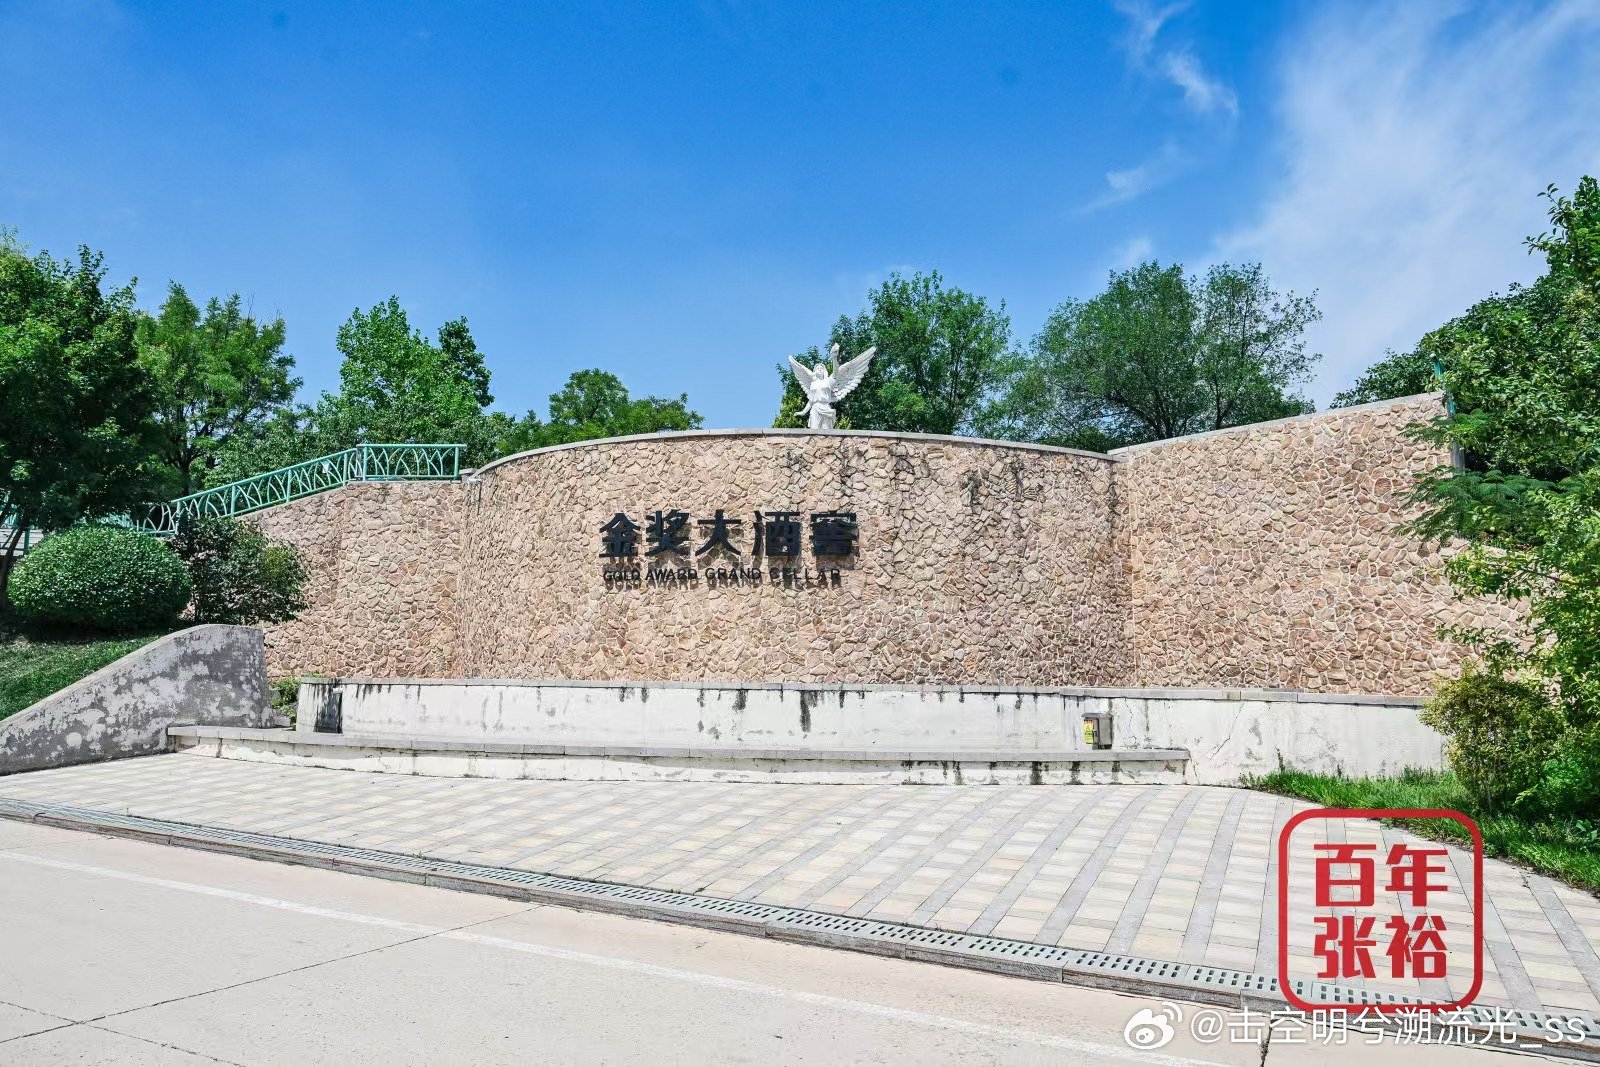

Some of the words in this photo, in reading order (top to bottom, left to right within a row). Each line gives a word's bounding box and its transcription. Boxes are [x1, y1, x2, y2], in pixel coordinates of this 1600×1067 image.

[599, 509, 858, 557] 金奖大酒窖
[603, 569, 641, 581] GOLD
[645, 567, 698, 581] AWARD
[704, 567, 761, 580] GRAND
